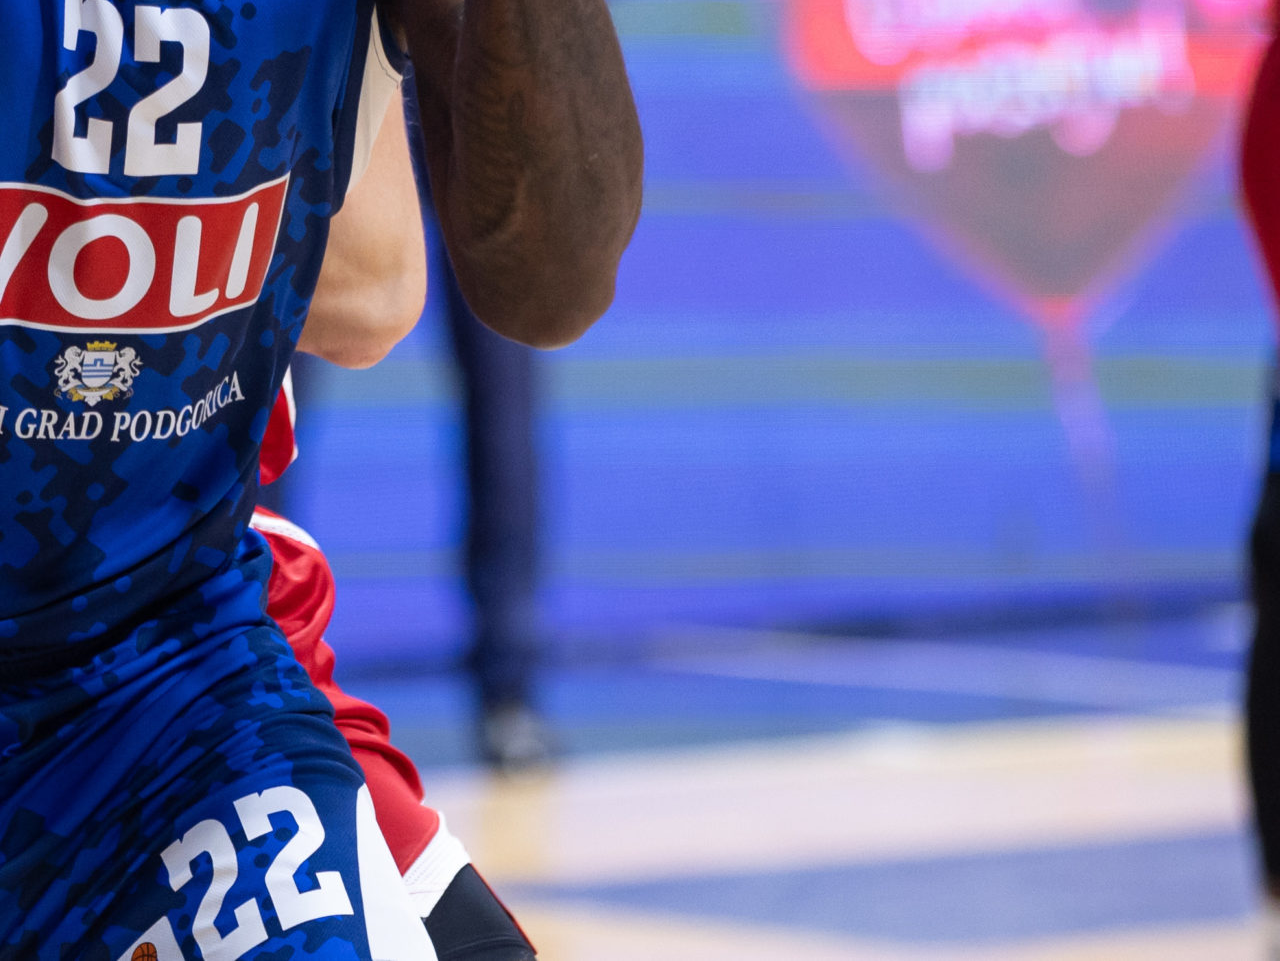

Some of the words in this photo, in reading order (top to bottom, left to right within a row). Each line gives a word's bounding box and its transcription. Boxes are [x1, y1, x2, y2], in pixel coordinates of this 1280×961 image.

[15, 407, 103, 440] GRAD
[110, 370, 245, 442] PODGORICA
[160, 786, 354, 961] 22
